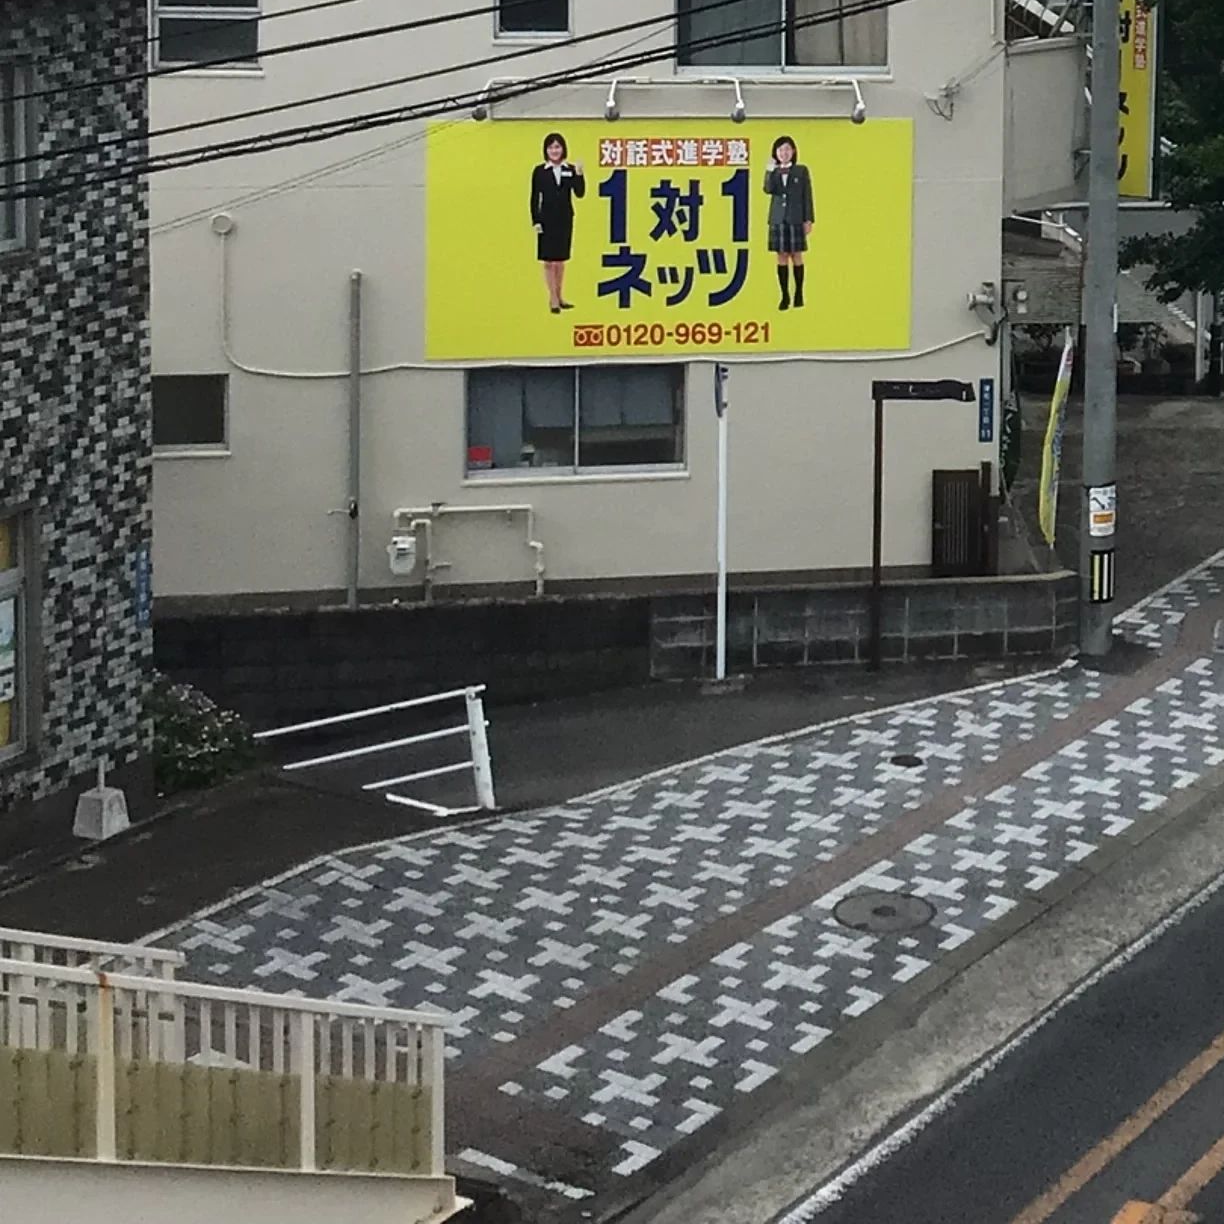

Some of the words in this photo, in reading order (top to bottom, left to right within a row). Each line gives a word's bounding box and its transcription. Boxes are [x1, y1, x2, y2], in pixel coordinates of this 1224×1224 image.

[600, 138, 750, 167] 対話式進学塾
[598, 169, 750, 244] 1対1
[597, 246, 749, 309] ネッツ
[607, 321, 770, 347] 0120-969-121
